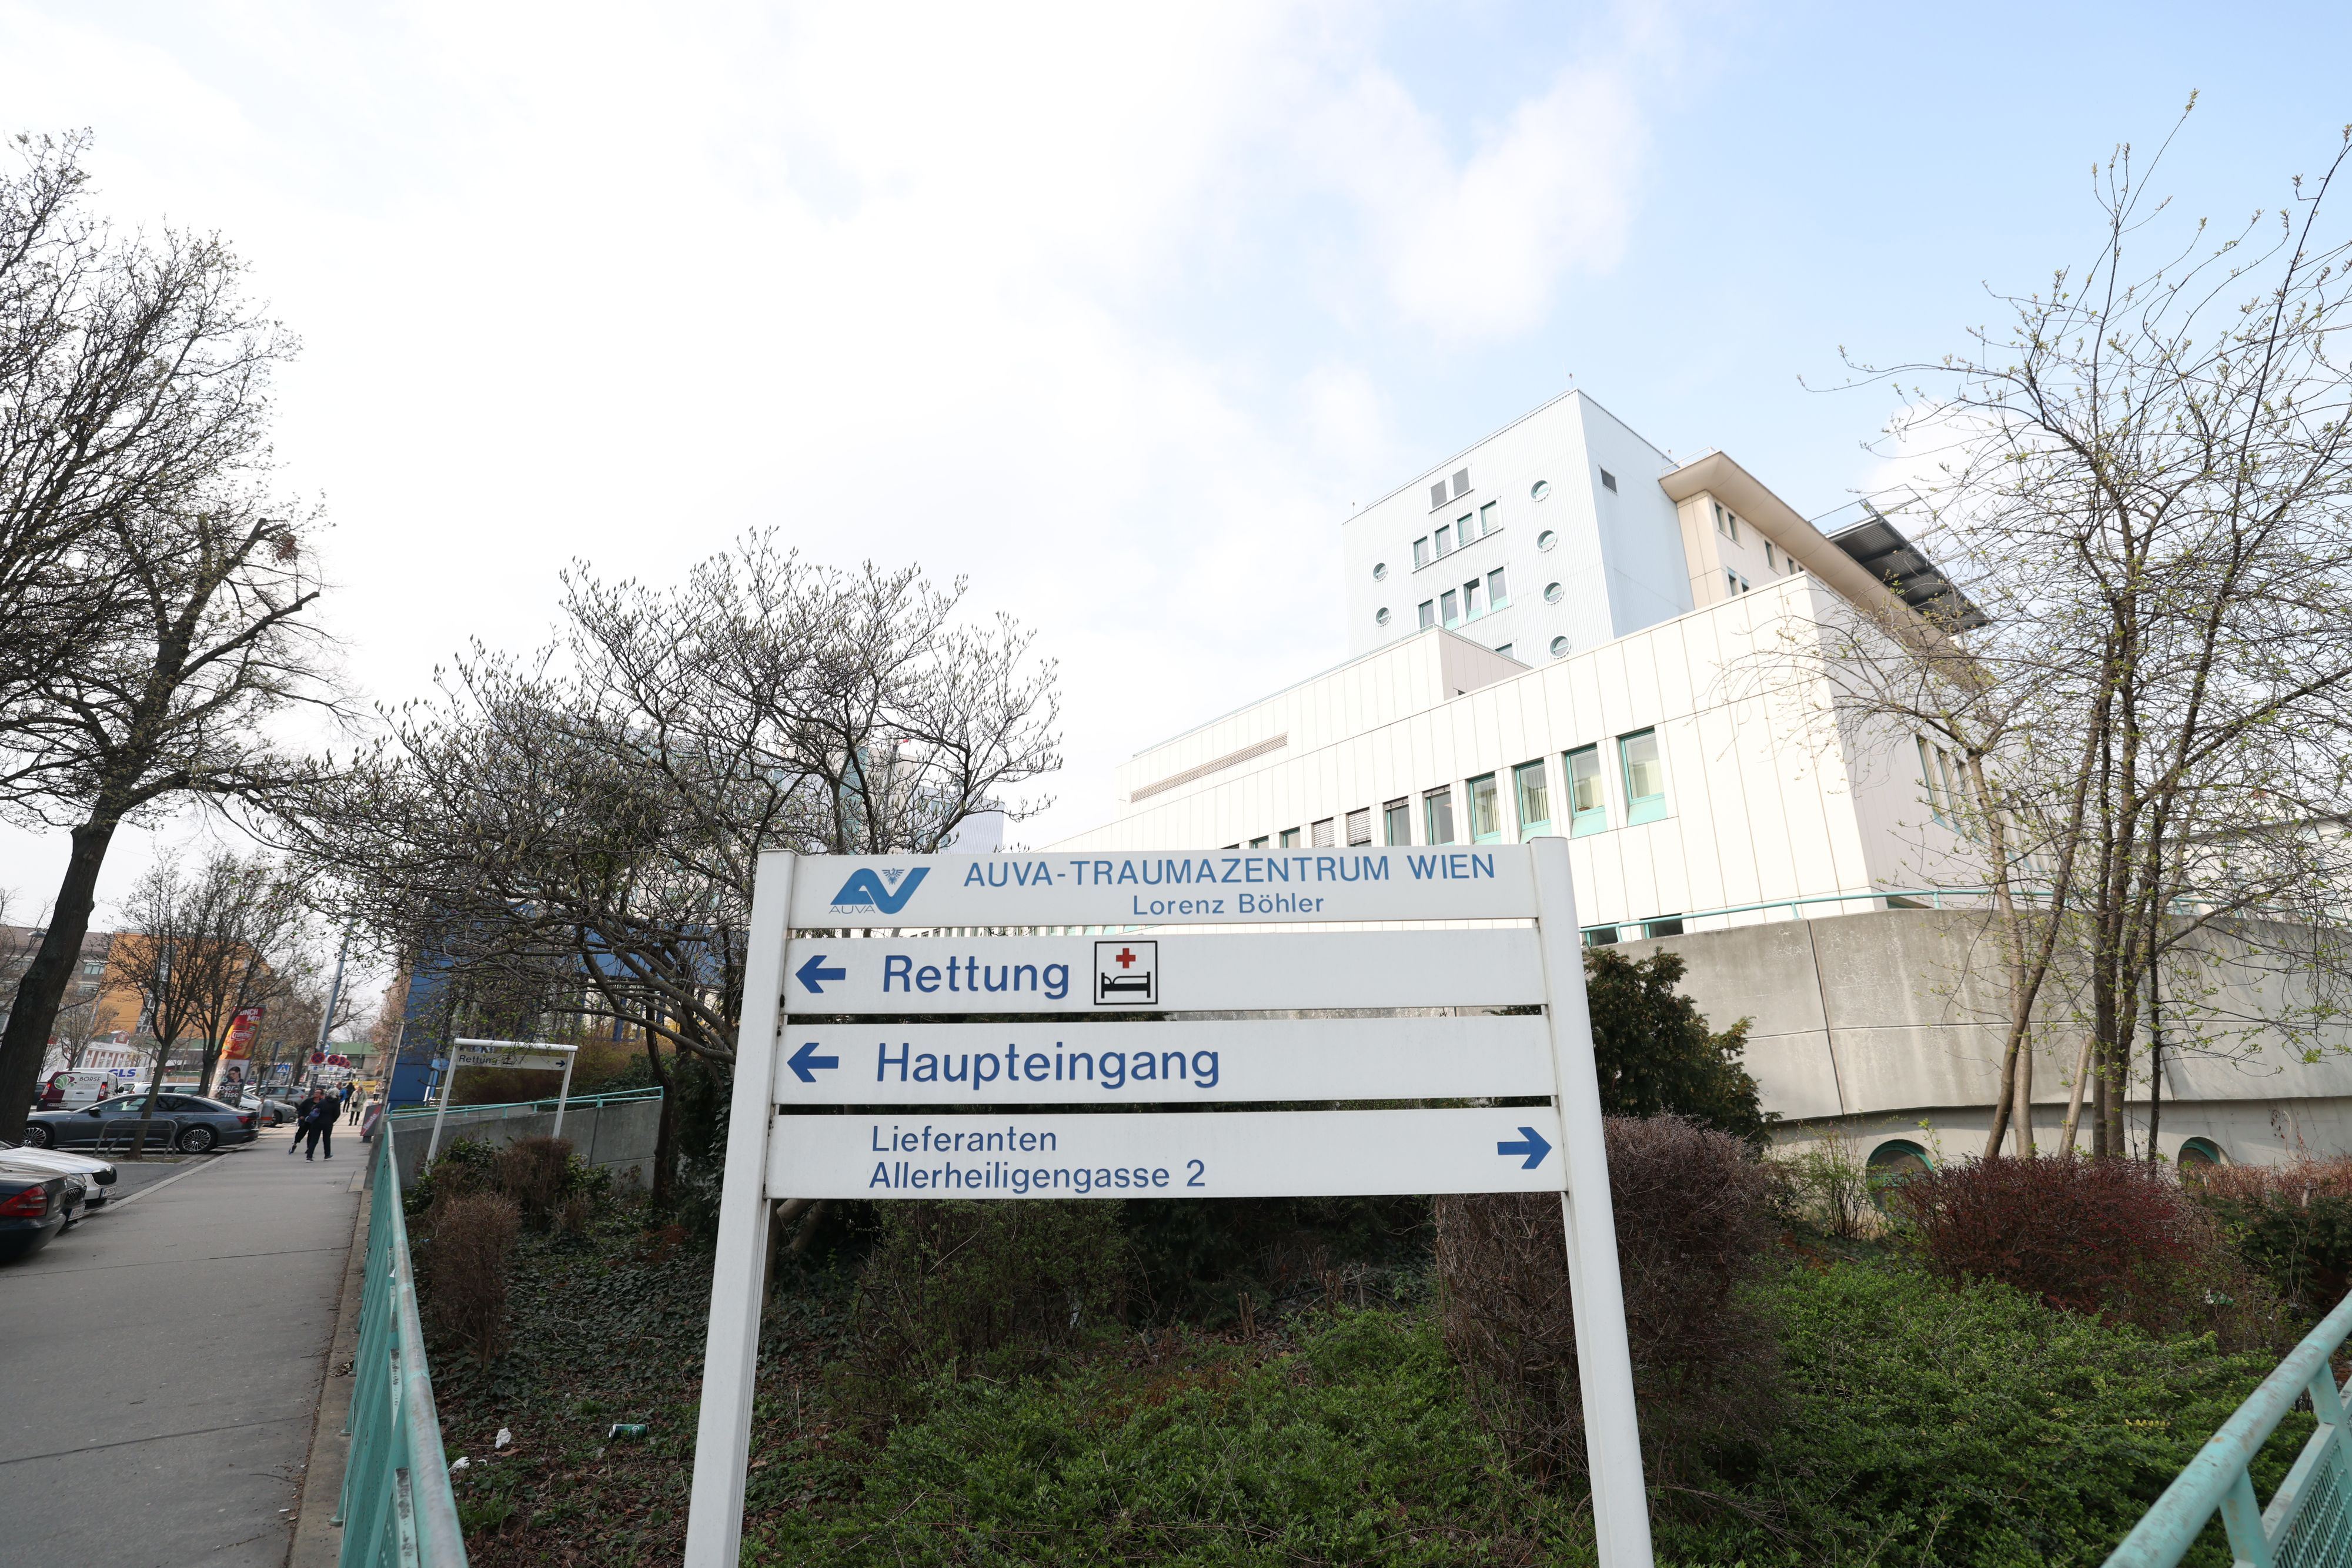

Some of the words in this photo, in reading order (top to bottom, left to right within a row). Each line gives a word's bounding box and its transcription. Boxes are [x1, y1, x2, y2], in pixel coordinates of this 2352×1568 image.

[963, 855, 1389, 888] AUVA-TRAUMAZENTRUM
[1406, 854, 1495, 880] WIEN
[828, 904, 876, 914] AUVA
[1132, 895, 1225, 916] Lorenz
[1238, 892, 1324, 914] Böhler
[883, 955, 1070, 1001] Rettung
[108, 1069, 136, 1077] GLS
[877, 1041, 1220, 1091] Haupteingang
[872, 1125, 1057, 1152] Lieferanten
[869, 1161, 1170, 1194] Allerheiligengasse
[1187, 1159, 1205, 1187] 2
